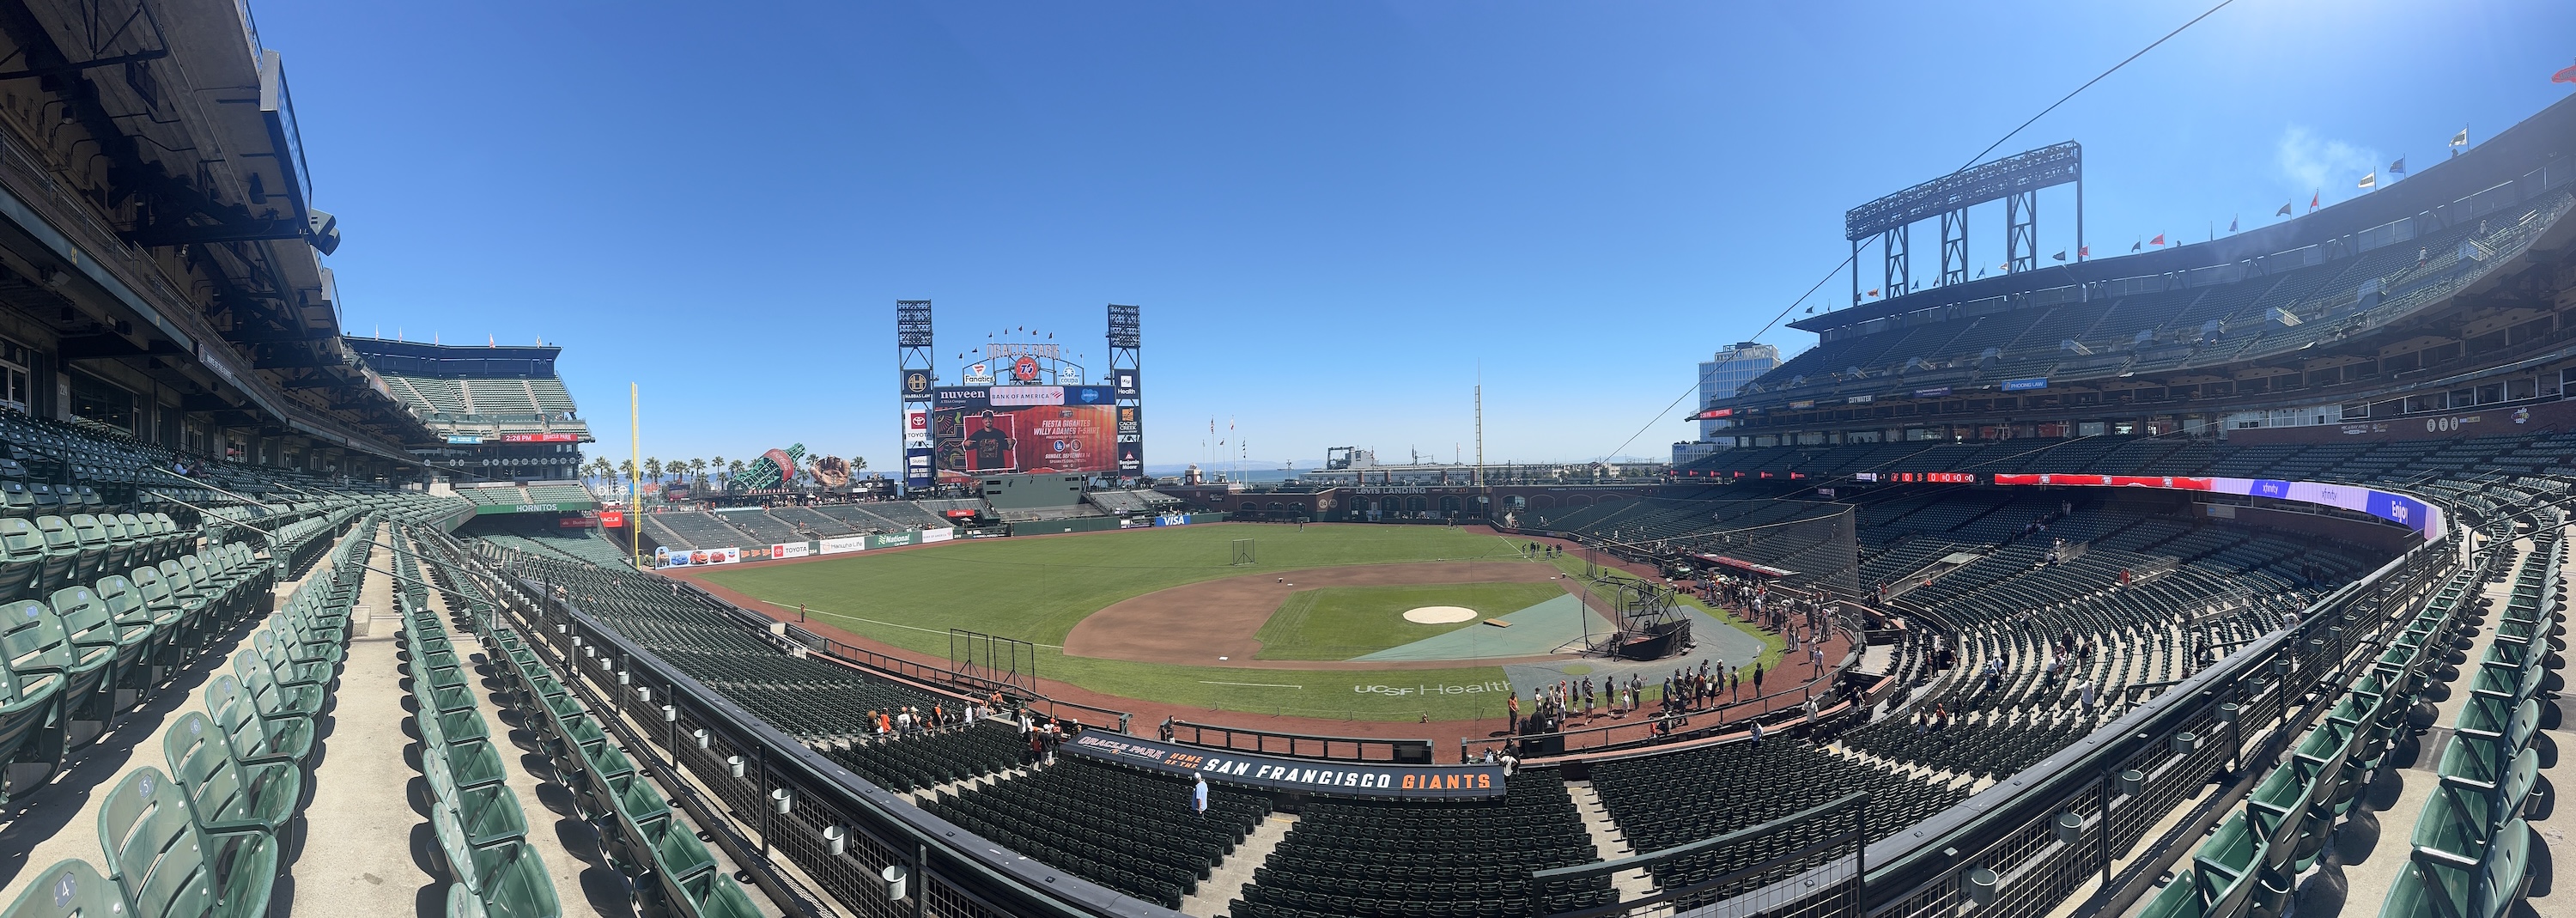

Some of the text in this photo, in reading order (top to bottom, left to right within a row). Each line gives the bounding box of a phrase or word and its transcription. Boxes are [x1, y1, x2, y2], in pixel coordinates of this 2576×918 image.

[987, 343, 1060, 360] ORACLE PARK
[1020, 363, 1033, 376] 76
[597, 483, 627, 495] blue
[2262, 483, 2279, 495] xfinity
[2321, 488, 2337, 503] xfinity
[516, 504, 557, 512] HORNITOS
[1164, 516, 1185, 526] VISA
[886, 534, 910, 543] National
[1354, 685, 1414, 696] UCSF
[193, 720, 198, 731] 6
[1077, 736, 1166, 760] ORACLE PARK
[1170, 753, 1203, 763] HOME
[1203, 759, 1491, 789] SAN FRANCISCO GIANTS
[143, 780, 149, 793] 5
[62, 881, 69, 896] 4
